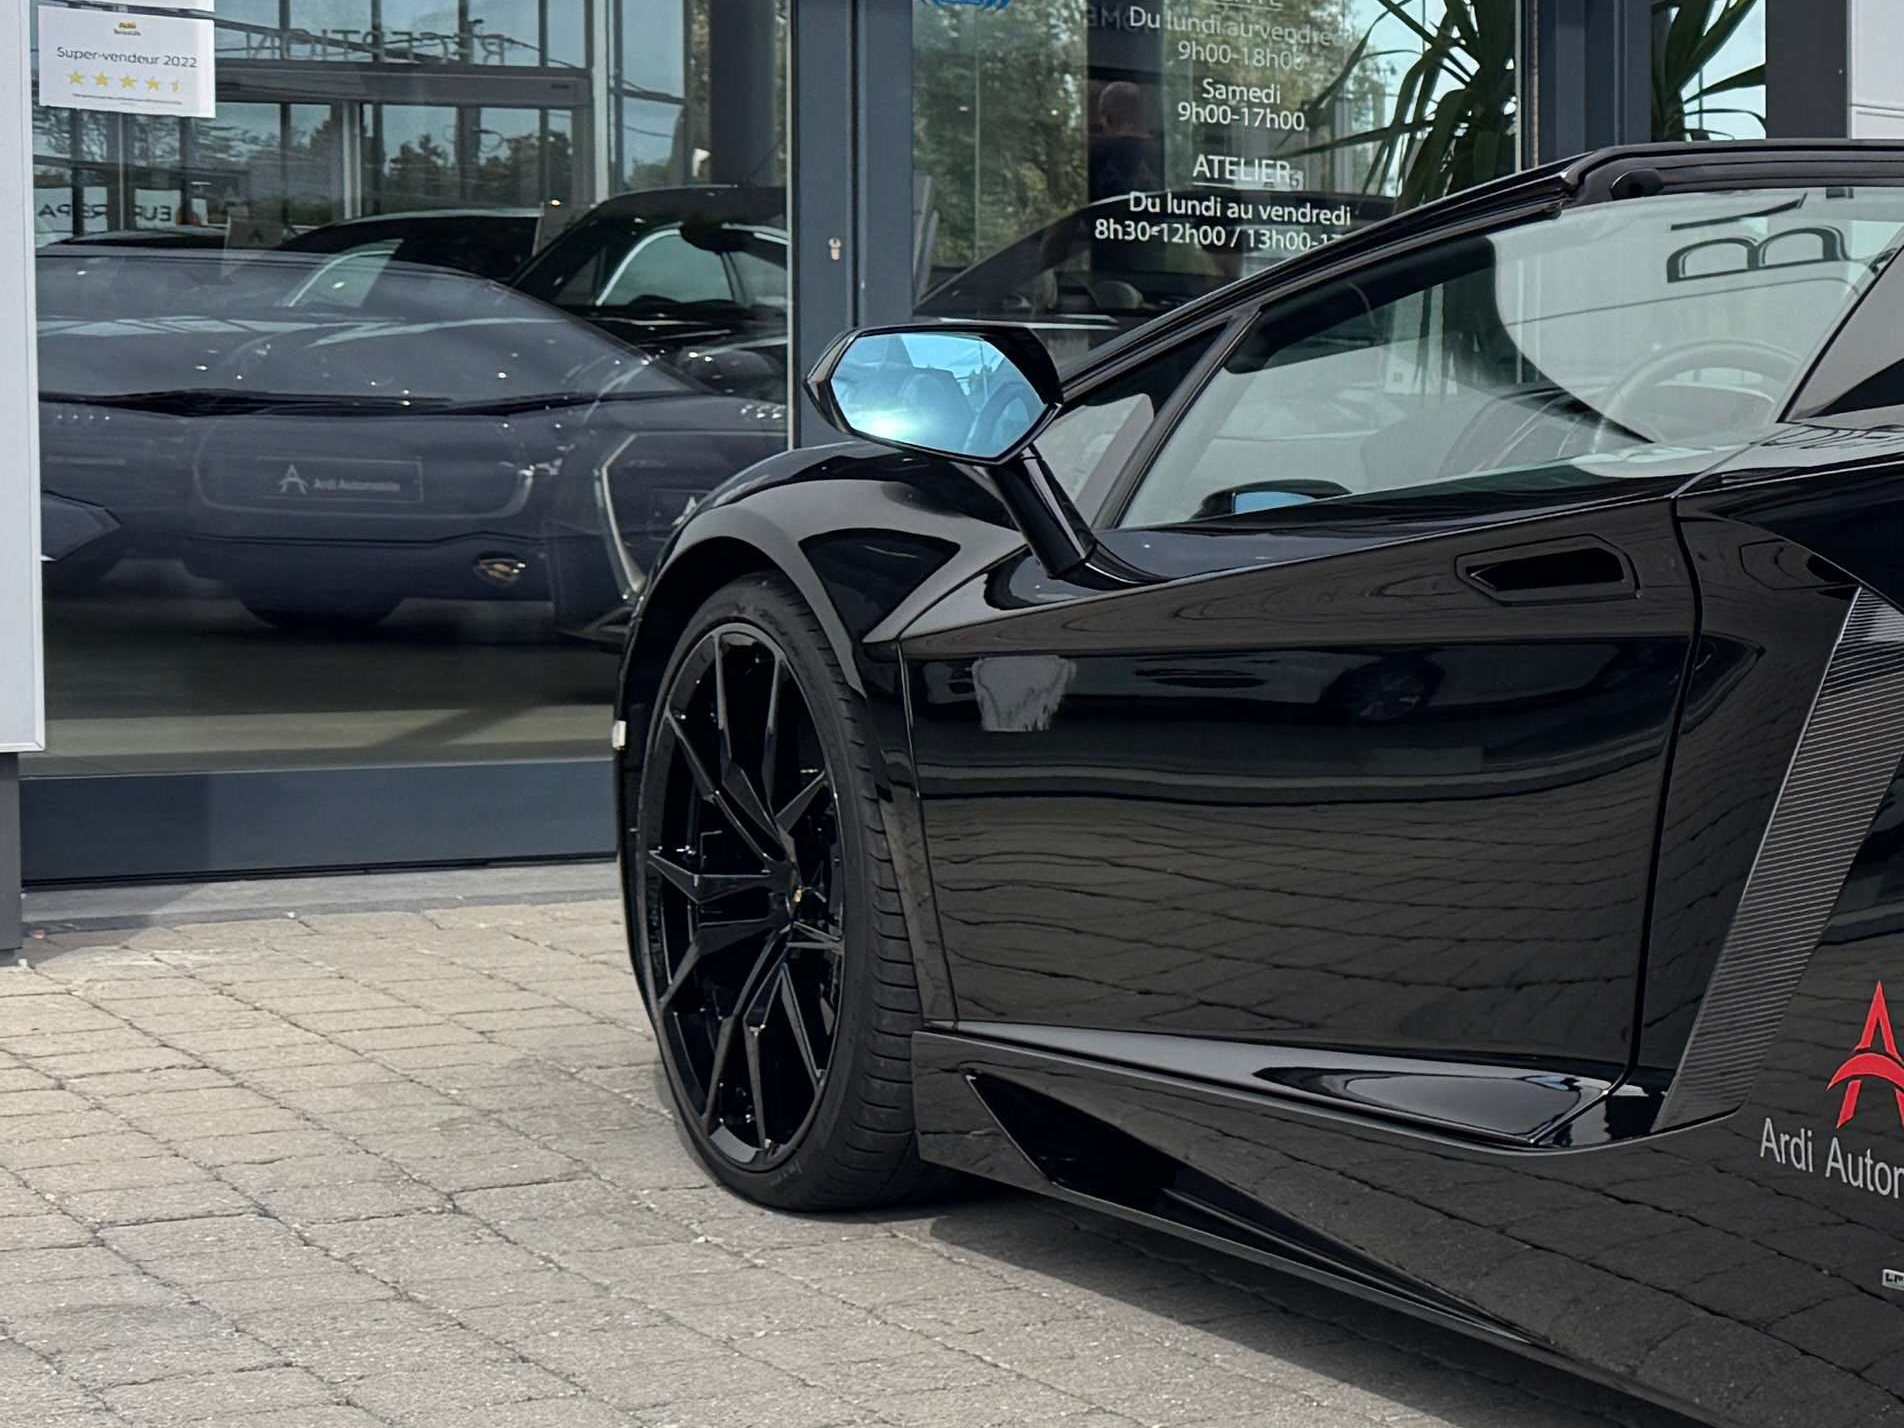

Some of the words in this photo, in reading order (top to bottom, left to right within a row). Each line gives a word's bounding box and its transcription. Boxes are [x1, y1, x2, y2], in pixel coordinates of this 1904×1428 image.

[1129, 6, 1161, 28] Du
[1167, 12, 1221, 36] lundi
[1227, 22, 1253, 38] au
[56, 46, 160, 65] Super-vendeur
[163, 55, 198, 68] 2022
[1178, 40, 1304, 70] 9h00-18h00
[1202, 78, 1281, 105] Samedi
[1178, 102, 1306, 131] 9h00-17h00
[1192, 154, 1290, 183] ATELIER
[1129, 191, 1160, 213] Du
[1167, 192, 1221, 218] lundi
[1226, 202, 1253, 219] au
[1259, 205, 1351, 227] vendredi
[1094, 219, 1226, 246] 8h30-12h00
[1249, 228, 1343, 251] 13h00-1
[1760, 1117, 1813, 1173] Ardi
